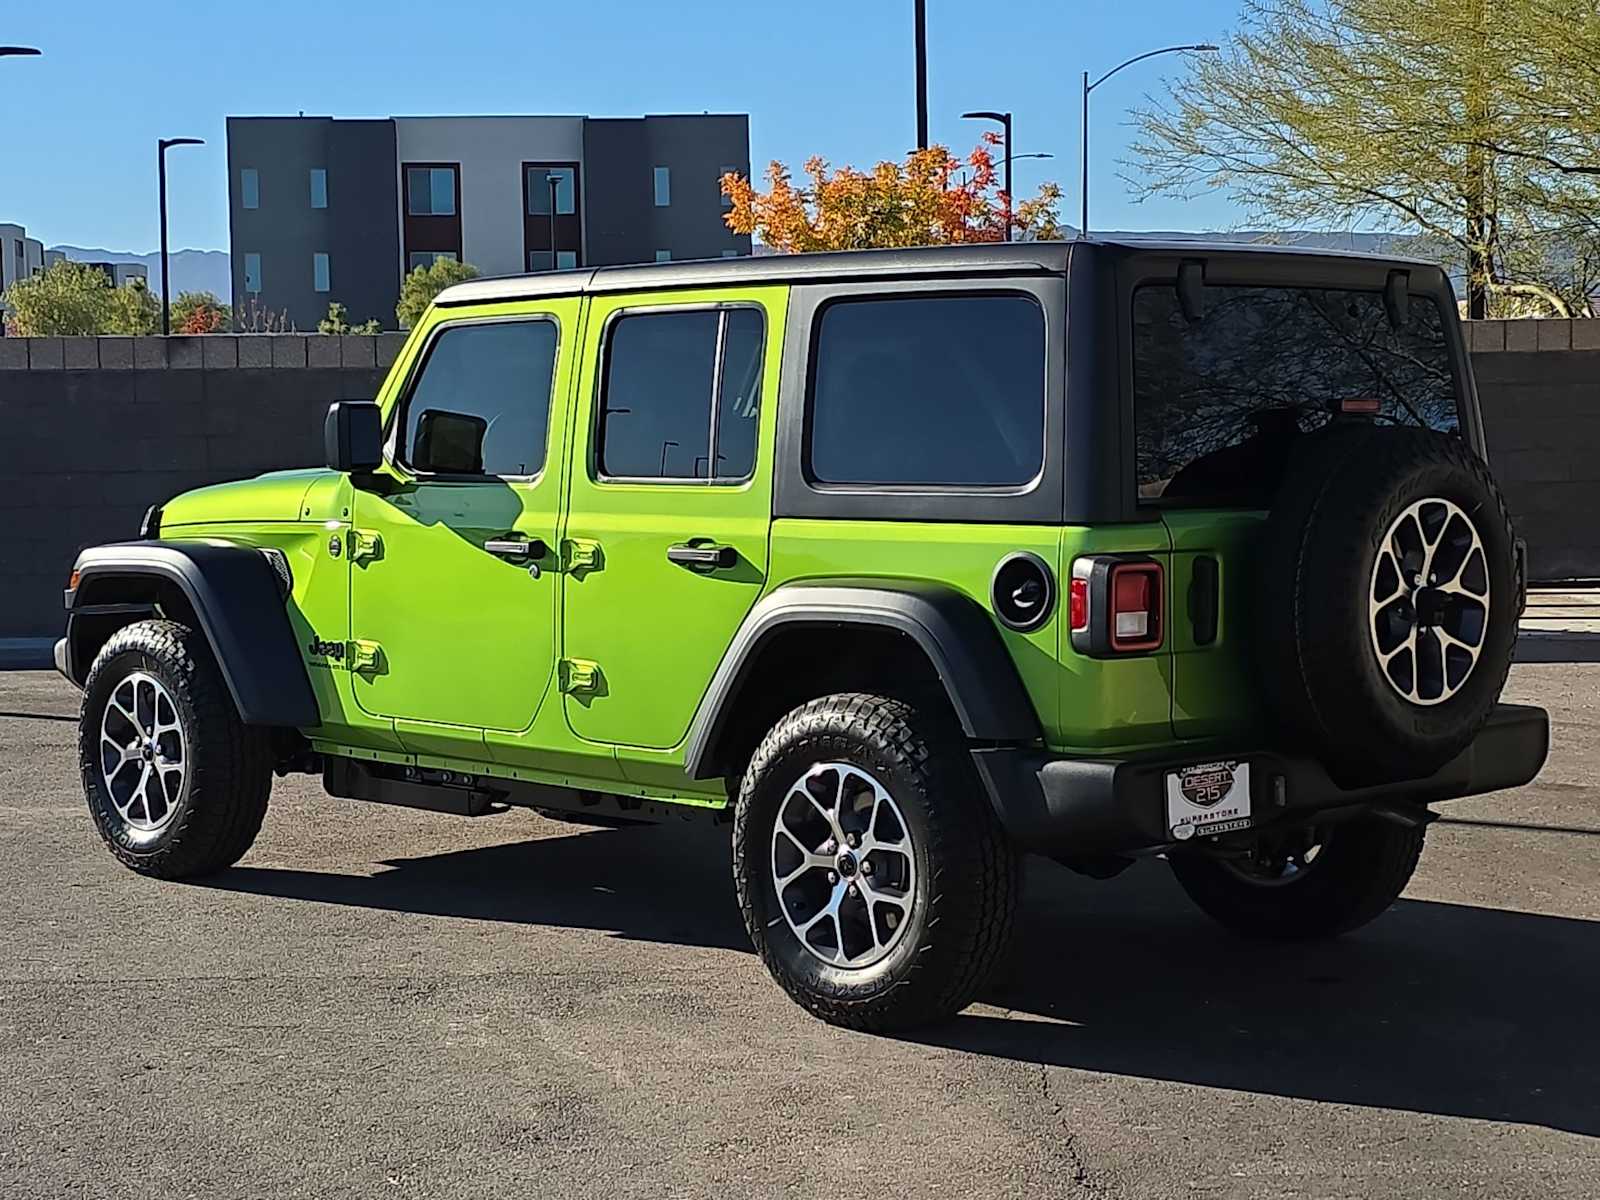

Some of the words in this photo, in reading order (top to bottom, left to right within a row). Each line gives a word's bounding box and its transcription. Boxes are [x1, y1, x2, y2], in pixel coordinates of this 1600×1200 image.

[309, 635, 345, 661] Jeep
[1184, 771, 1229, 787] DESERT
[1196, 786, 1221, 802] 215
[1180, 808, 1239, 823] SUPERSTORE
